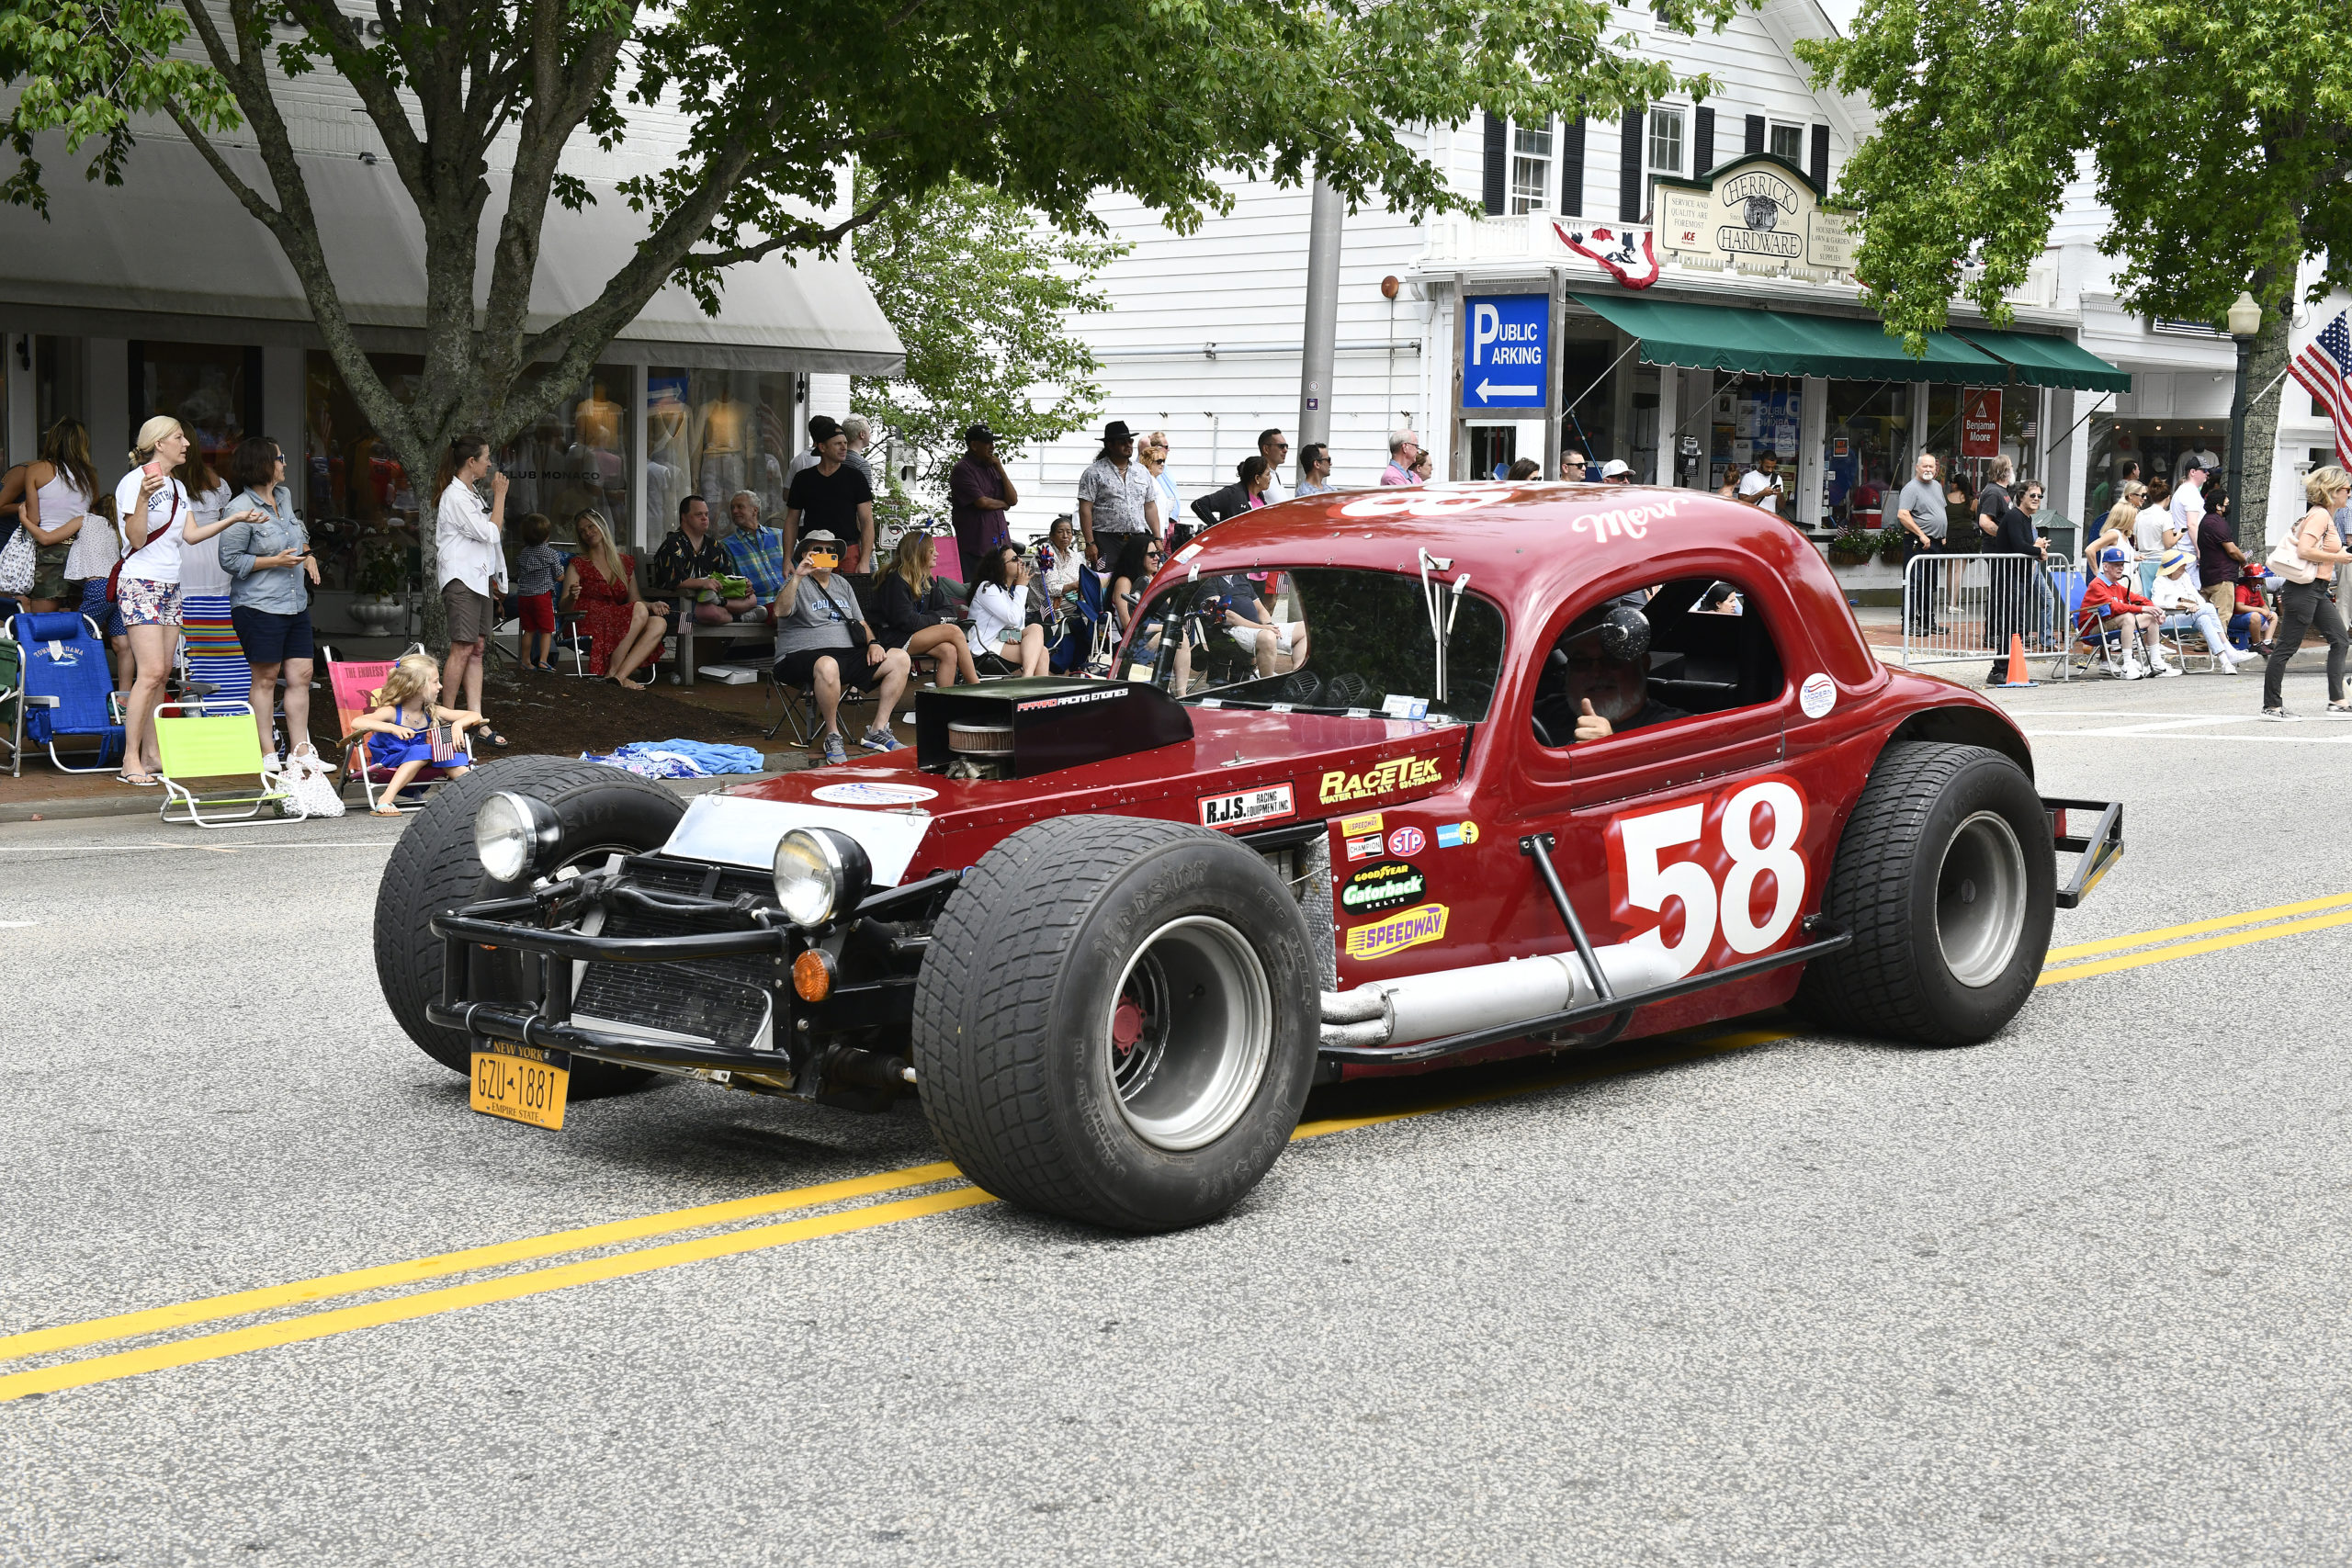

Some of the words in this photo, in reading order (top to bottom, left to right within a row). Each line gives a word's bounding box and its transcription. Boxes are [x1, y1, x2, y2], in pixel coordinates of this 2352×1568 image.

[1728, 175, 1793, 209] HERRICK
[1671, 197, 1695, 208] SERVICE
[1697, 200, 1709, 209] AND
[1670, 208, 1696, 218] QUALITY
[1698, 211, 1709, 220] ARE
[1674, 218, 1705, 230] FOREMOST
[1824, 218, 1839, 226] PAINT
[1681, 231, 1696, 242] ACE
[1721, 229, 1798, 255] HARDWARE
[1830, 236, 1850, 245] GARDEN
[1823, 244, 1838, 253] TOOLS
[1819, 253, 1841, 262] SUPPLIES
[1966, 419, 1996, 433] Benjamin
[1969, 431, 1991, 442] Moore
[506, 470, 537, 479] LUB
[541, 471, 601, 480] MONACO
[1571, 497, 1690, 544] Merv
[33, 646, 51, 658] TOMM
[61, 645, 85, 656] AHAMA
[345, 667, 356, 679] THE
[358, 665, 384, 679] ENDLESS
[1017, 698, 1057, 712] PIPPARD
[1057, 694, 1091, 706] RACING
[1091, 687, 1129, 701] ENGINES
[1319, 791, 1352, 806] WATER
[1352, 787, 1377, 800] MILL,
[1377, 784, 1394, 795] N.Y.
[1206, 796, 1247, 824] R.J.S.
[1256, 790, 1277, 805] RACING
[1350, 840, 1381, 854] CHAMPION
[1393, 829, 1422, 853] STP
[1353, 863, 1409, 883] GOODYEAR
[1620, 782, 1806, 981] 58
[1341, 874, 1424, 906] Gatorback
[1365, 897, 1405, 909] BELTS
[1365, 912, 1442, 949] SPEEDWAY
[492, 1040, 516, 1055] NEW
[518, 1045, 544, 1062] YORK
[478, 1058, 506, 1100] GZU
[518, 1066, 555, 1111] 1881
[492, 1101, 516, 1117] EMPIRE
[518, 1109, 540, 1122] STATE
